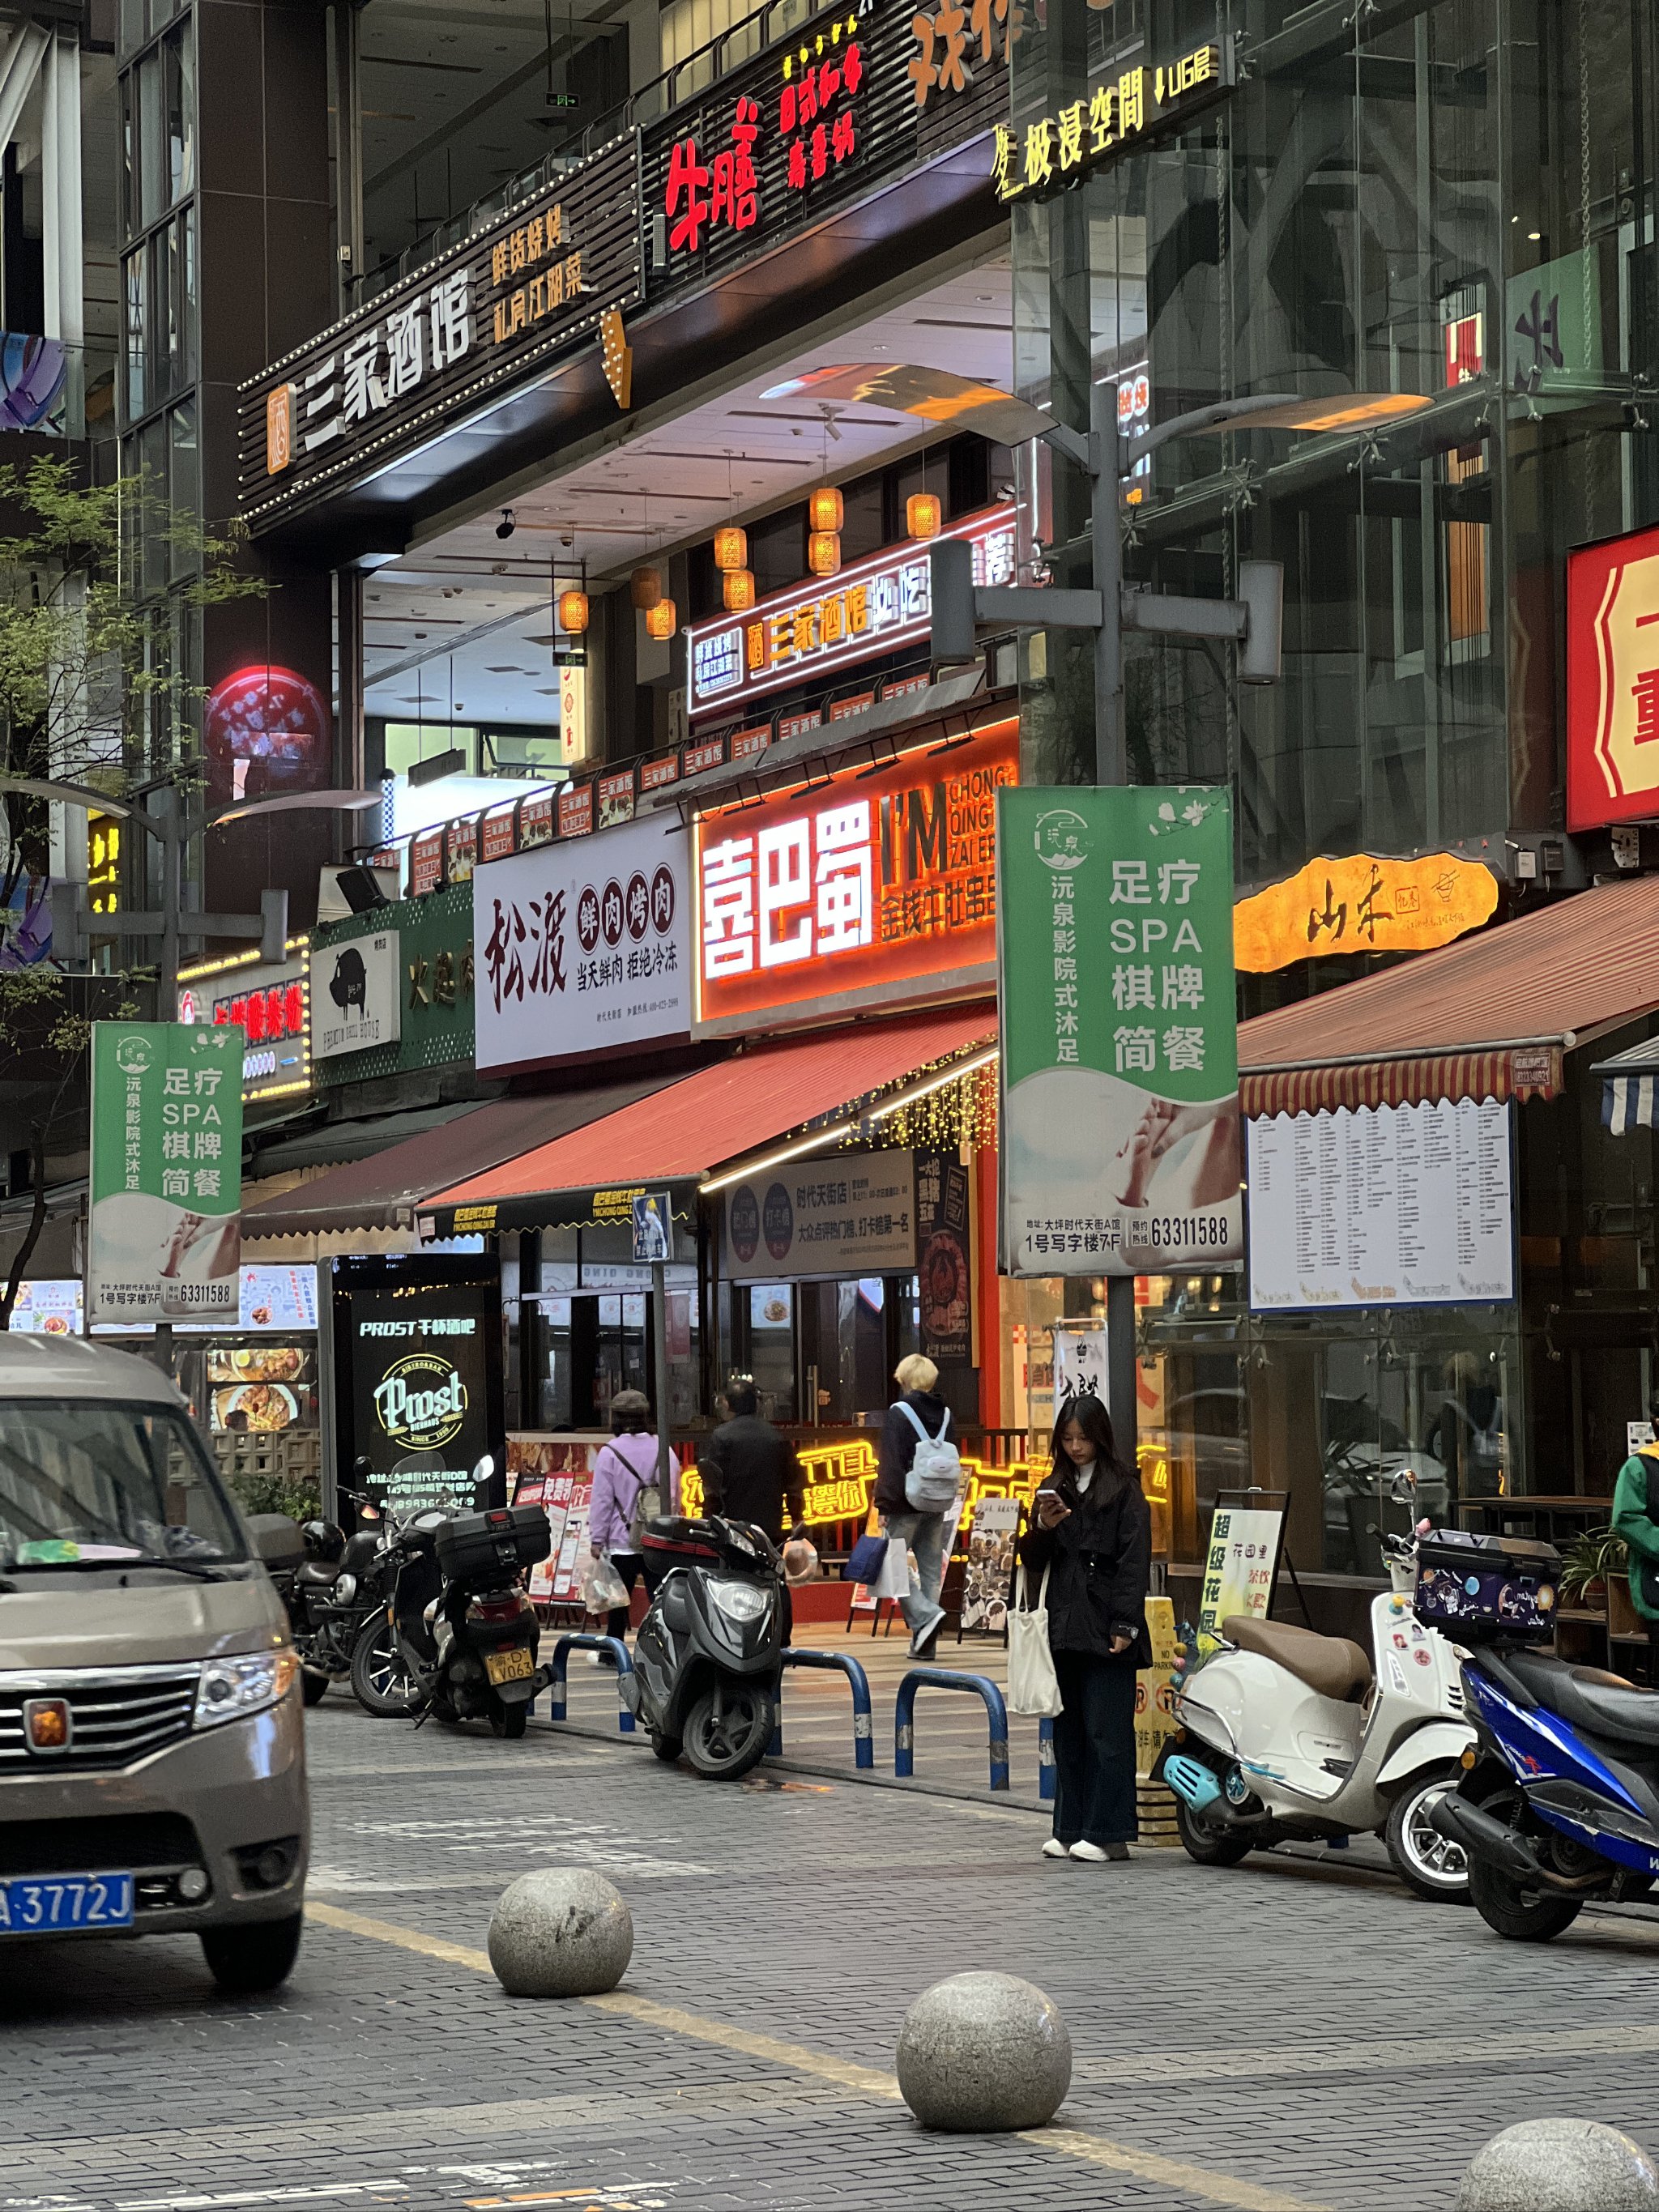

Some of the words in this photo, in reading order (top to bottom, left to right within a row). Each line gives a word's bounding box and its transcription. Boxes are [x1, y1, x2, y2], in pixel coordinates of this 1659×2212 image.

[780, 43, 862, 134] 日式和牛
[666, 96, 759, 251] 牛膳
[492, 203, 562, 287] 鲜货烧烤
[494, 251, 582, 344] 私房江湖菜
[305, 269, 469, 452] 三家酒馆
[781, 714, 821, 739] 三家酒馆
[686, 744, 722, 774] 三家酒馆
[735, 734, 768, 757] 三家酒馆
[599, 774, 633, 799] 三家酒馆
[645, 764, 675, 787] 三家酒馆
[521, 801, 552, 825] 三家酒馆
[562, 792, 590, 815] 三家酒馆
[486, 820, 511, 838] 三家酒馆
[881, 782, 947, 885] I'M
[949, 766, 1005, 804] CHONG
[950, 803, 994, 836] QING
[449, 825, 477, 848] 三家酒馆
[416, 842, 440, 861] 三家酒馆
[702, 799, 872, 979] 喜巴蜀
[1109, 859, 1201, 905] 足疗
[580, 878, 671, 941] 鲜肉烤肉
[1110, 918, 1202, 953] SPA
[578, 954, 623, 991] 当天鲜肉
[628, 940, 678, 980] 拒绝冷冻
[1051, 875, 1079, 1063] 沅泉影院式沐足
[1112, 964, 1205, 1011] 棋牌
[1113, 1025, 1205, 1072] 简餐
[163, 1068, 223, 1096] 足疗
[162, 1104, 222, 1125] SPA
[125, 1076, 142, 1190] 沅泉影院式沐足
[162, 1131, 222, 1160] 棋牌
[162, 1168, 221, 1197] 简餐
[796, 1182, 847, 1208] 时代天街店
[1026, 1218, 1121, 1232] 地址:大坪时代天街A馆
[1132, 1220, 1149, 1232] 预约
[1151, 1217, 1229, 1247] 63311588
[1025, 1233, 1121, 1254] 1号写字楼7F
[100, 1293, 162, 1305] 1号写字楼7F
[181, 1285, 230, 1302] 63311588
[360, 1321, 417, 1336] PROST
[417, 1318, 476, 1335] 干杯酒吧
[373, 1370, 463, 1429] Prost
[1233, 1542, 1269, 1560] 花园里
[1199, 1514, 1231, 1634] 超级花园
[1161, 1650, 1171, 1660] NO
[490, 1661, 532, 1683] LV063
